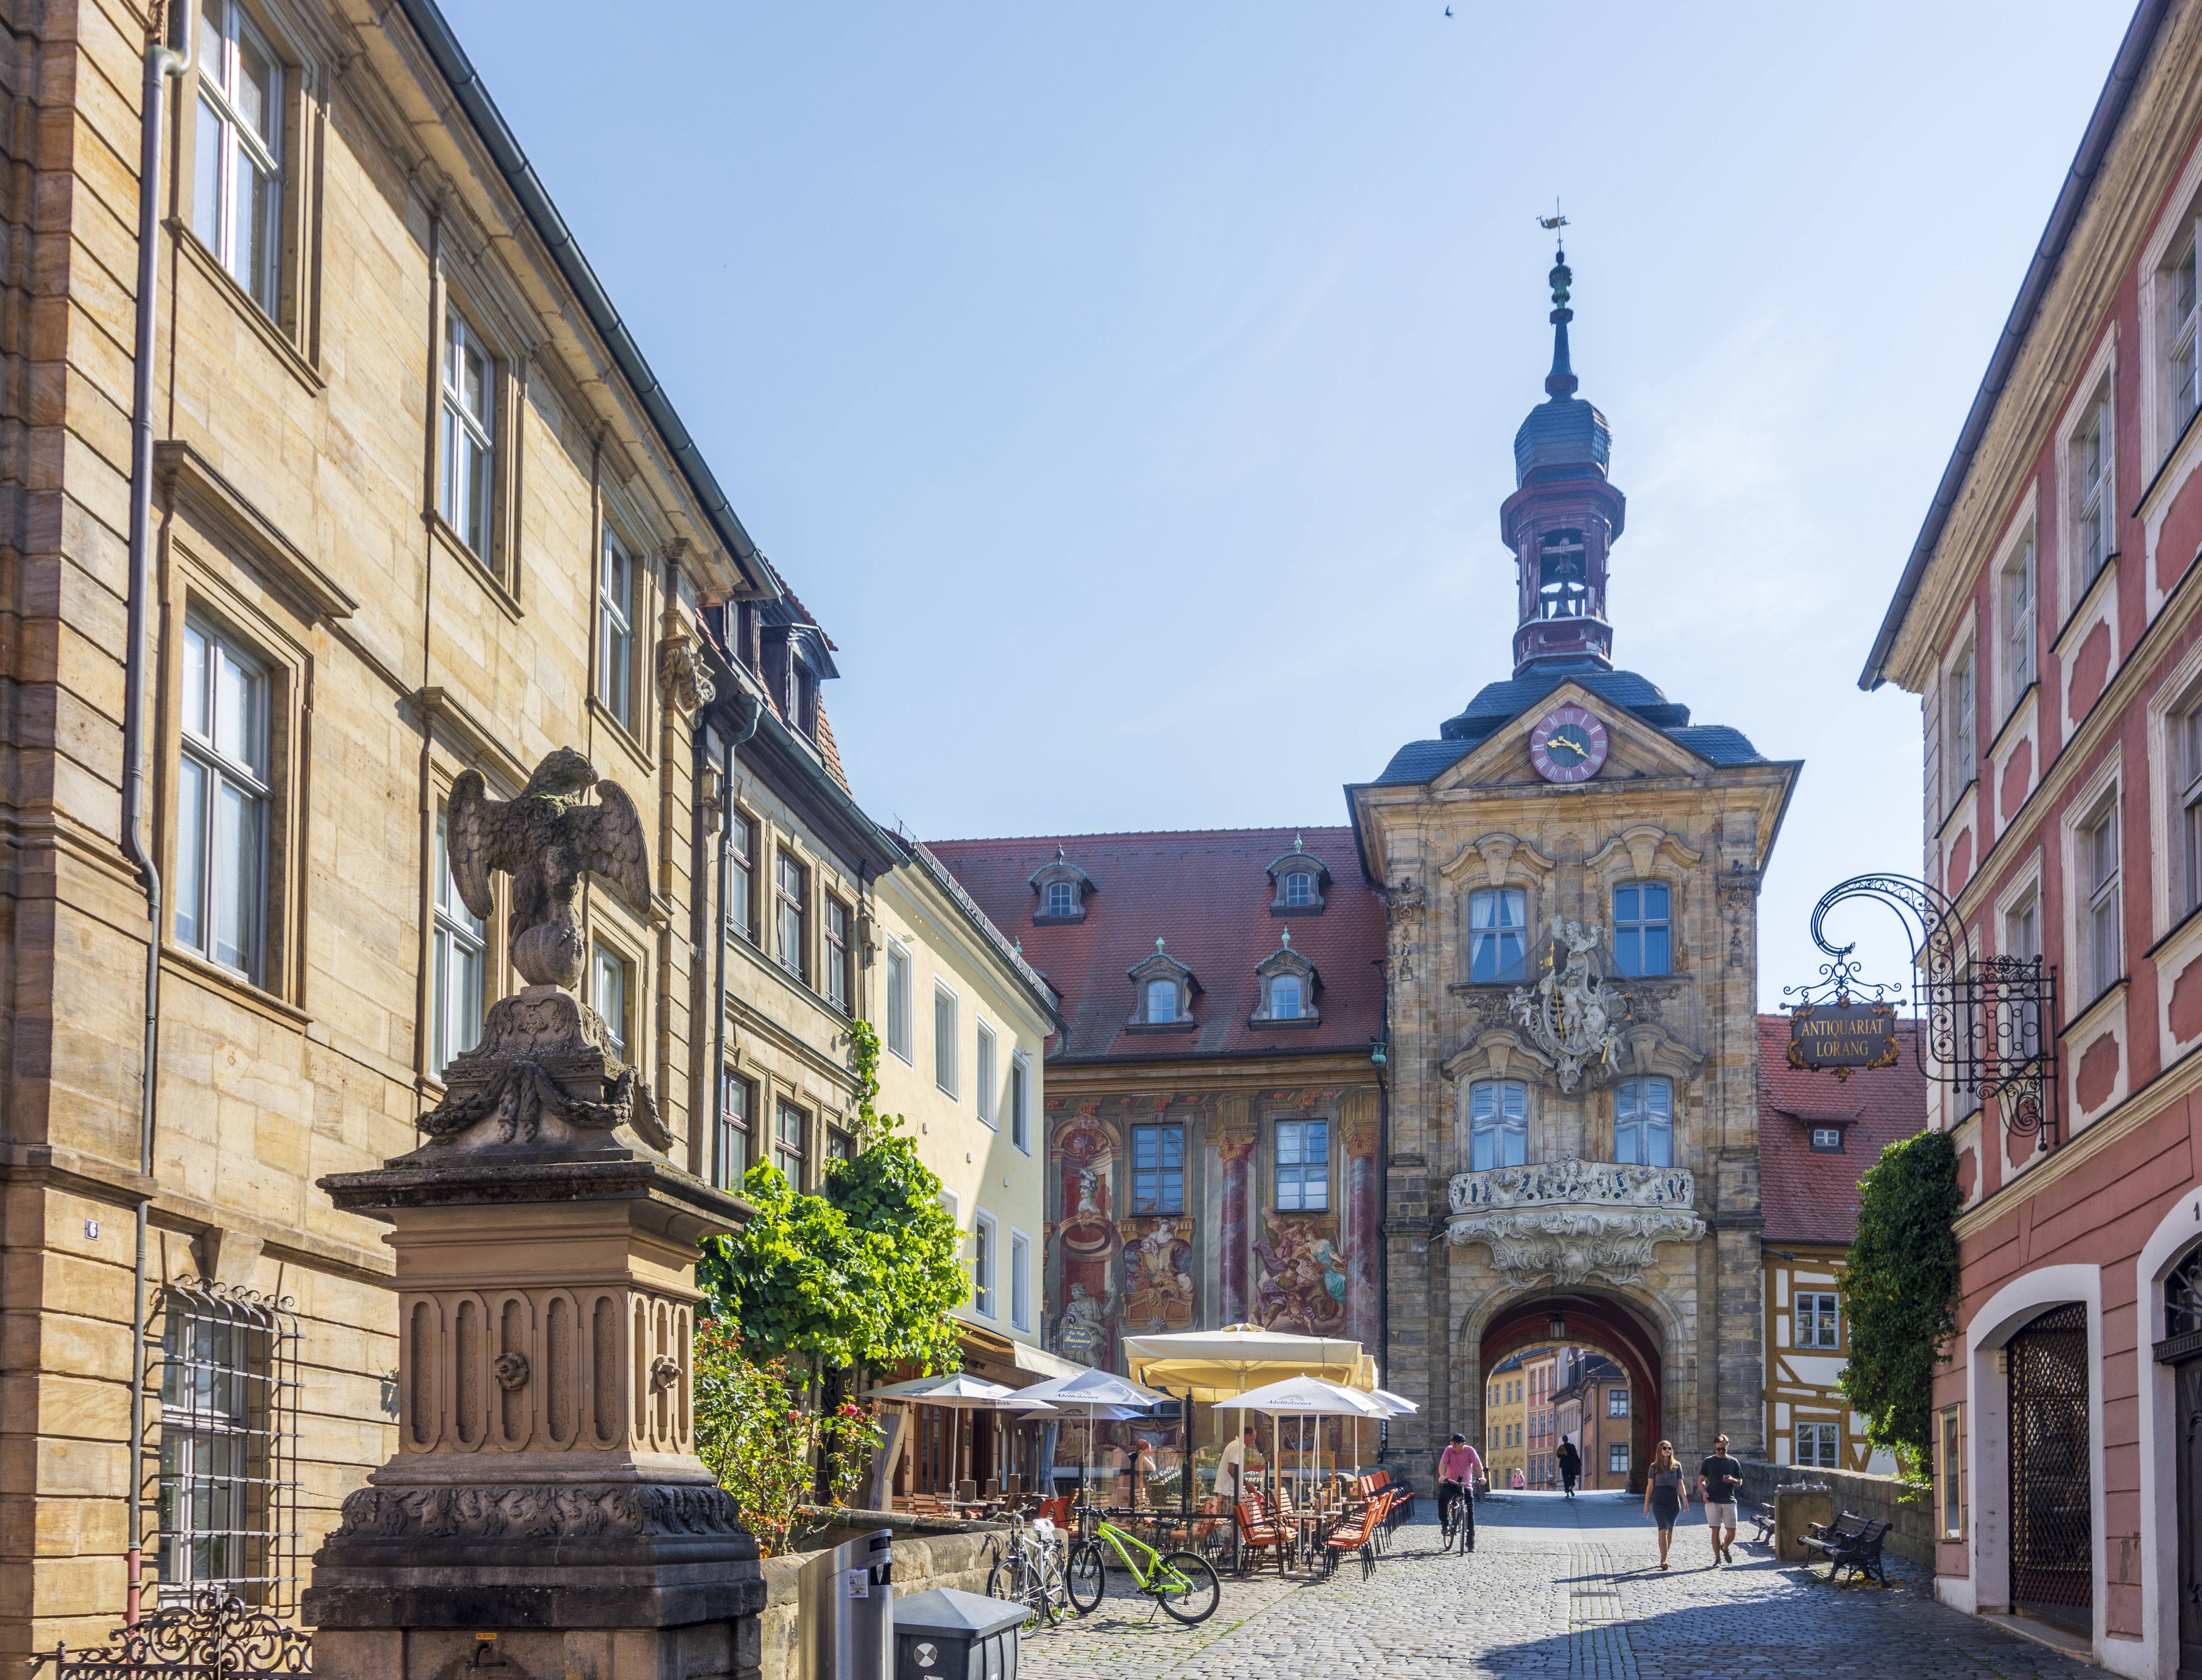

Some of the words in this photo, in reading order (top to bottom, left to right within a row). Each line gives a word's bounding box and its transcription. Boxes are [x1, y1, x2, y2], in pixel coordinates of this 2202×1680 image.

[1801, 1019, 1884, 1038] ANTIQUARIAT
[1816, 1040, 1869, 1057] LORANG
[90, 1222, 97, 1237] 6
[1064, 1335, 1091, 1343] Bassanese
[1161, 1470, 1182, 1485] sanese
